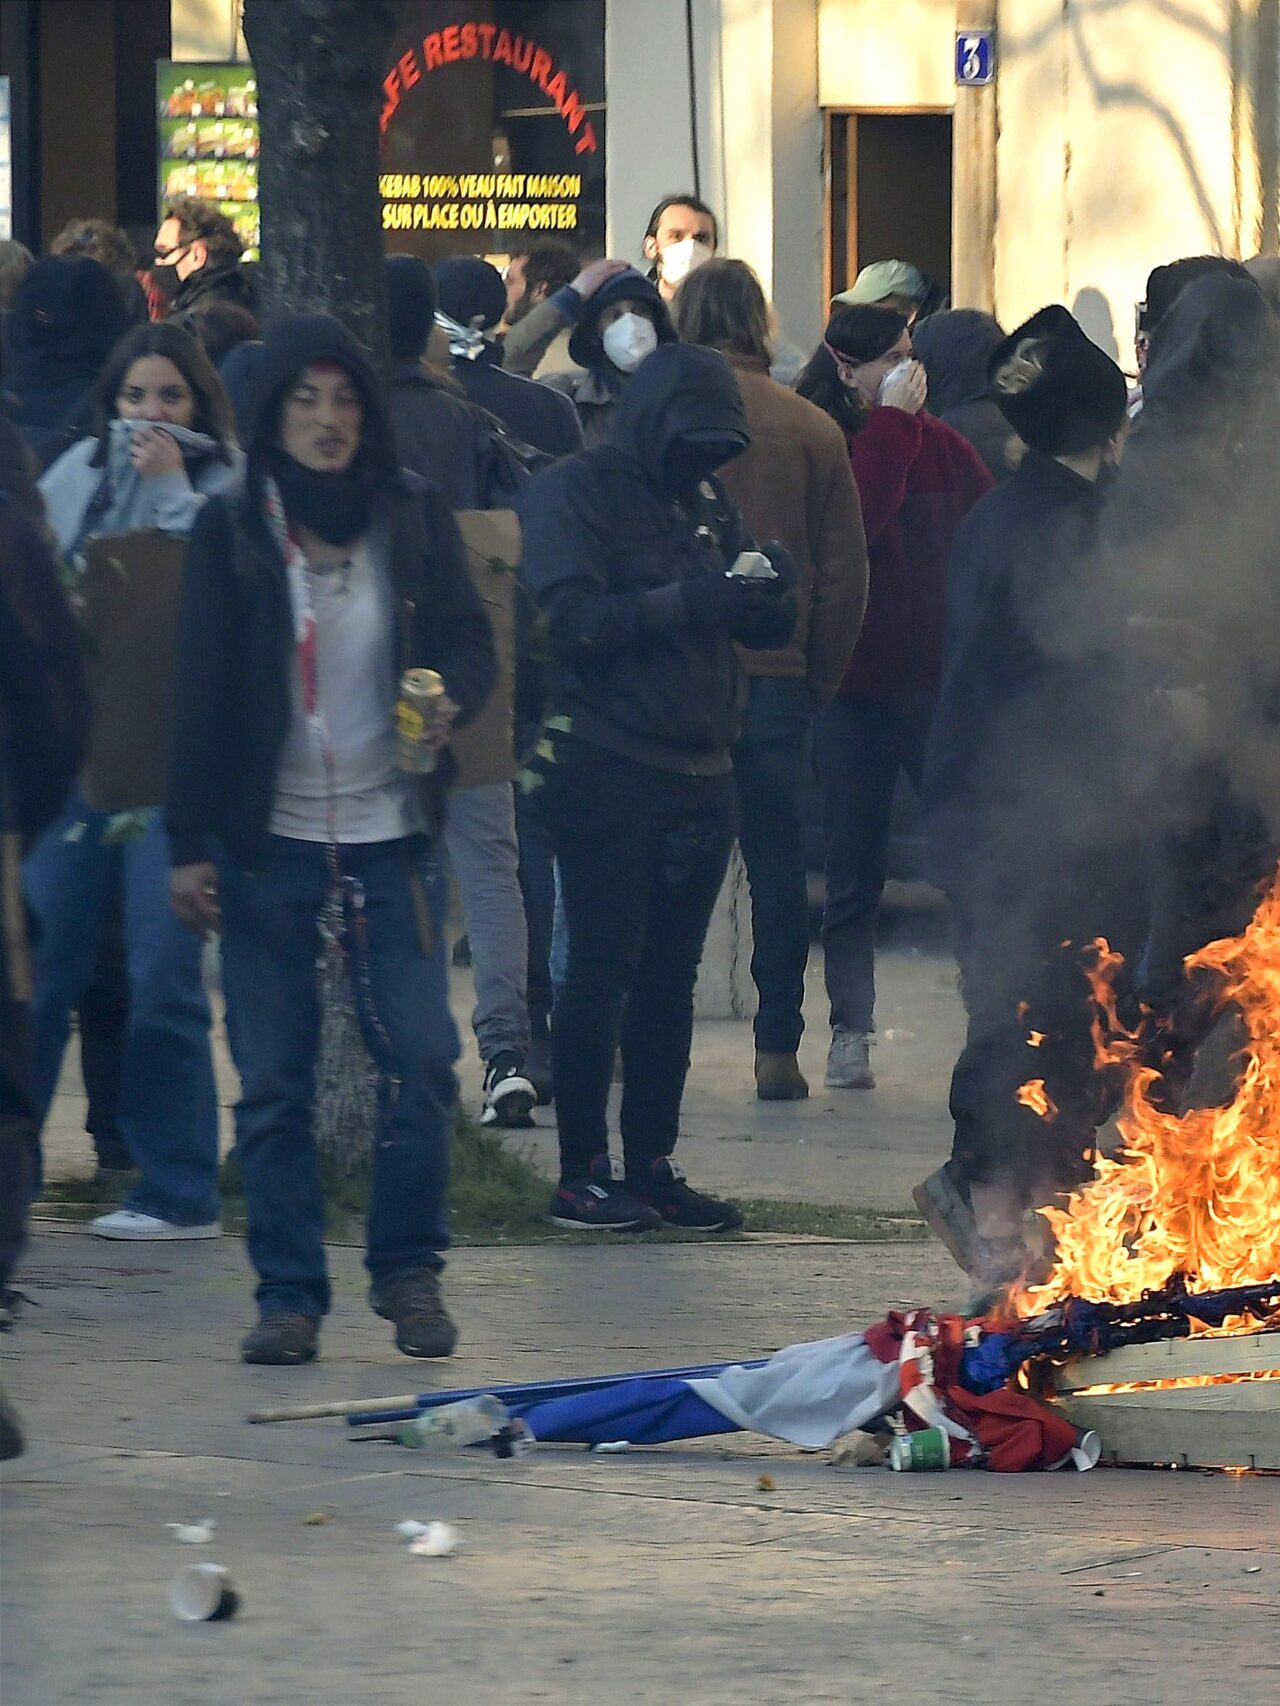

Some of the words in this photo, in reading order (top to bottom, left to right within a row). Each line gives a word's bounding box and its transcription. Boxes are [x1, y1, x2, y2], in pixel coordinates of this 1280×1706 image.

[963, 38, 981, 80] 3
[423, 23, 597, 155] RESTAURANT
[379, 175, 421, 198] KEBAB
[422, 175, 459, 198] 100%
[460, 175, 495, 198] VEAU
[496, 175, 526, 198] FAIT
[526, 175, 581, 198] MAISON
[382, 204, 412, 229] SUR
[413, 204, 459, 229] PLACE
[460, 204, 484, 229] OU
[498, 204, 577, 229] EMPORTER
